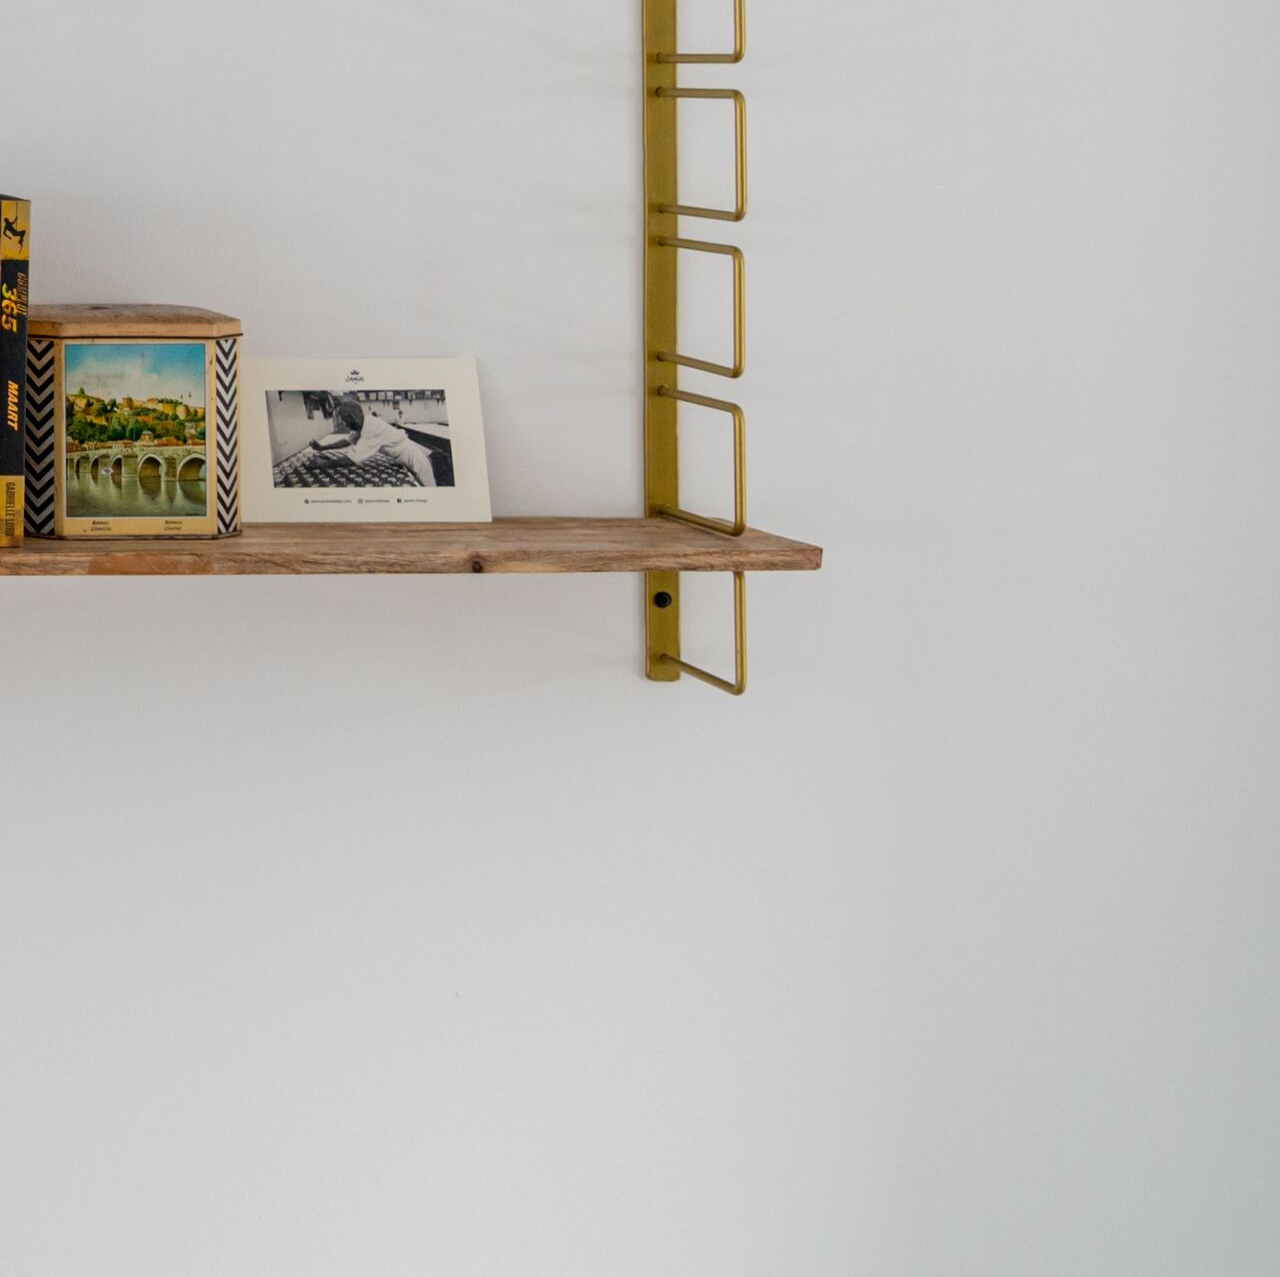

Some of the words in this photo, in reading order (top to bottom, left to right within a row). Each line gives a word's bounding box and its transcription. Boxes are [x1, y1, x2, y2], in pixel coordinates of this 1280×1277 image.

[1, 282, 18, 334] 365
[17, 272, 28, 316] COMPLOT
[7, 379, 20, 432] MAART
[5, 482, 16, 518] GABRIELLE
